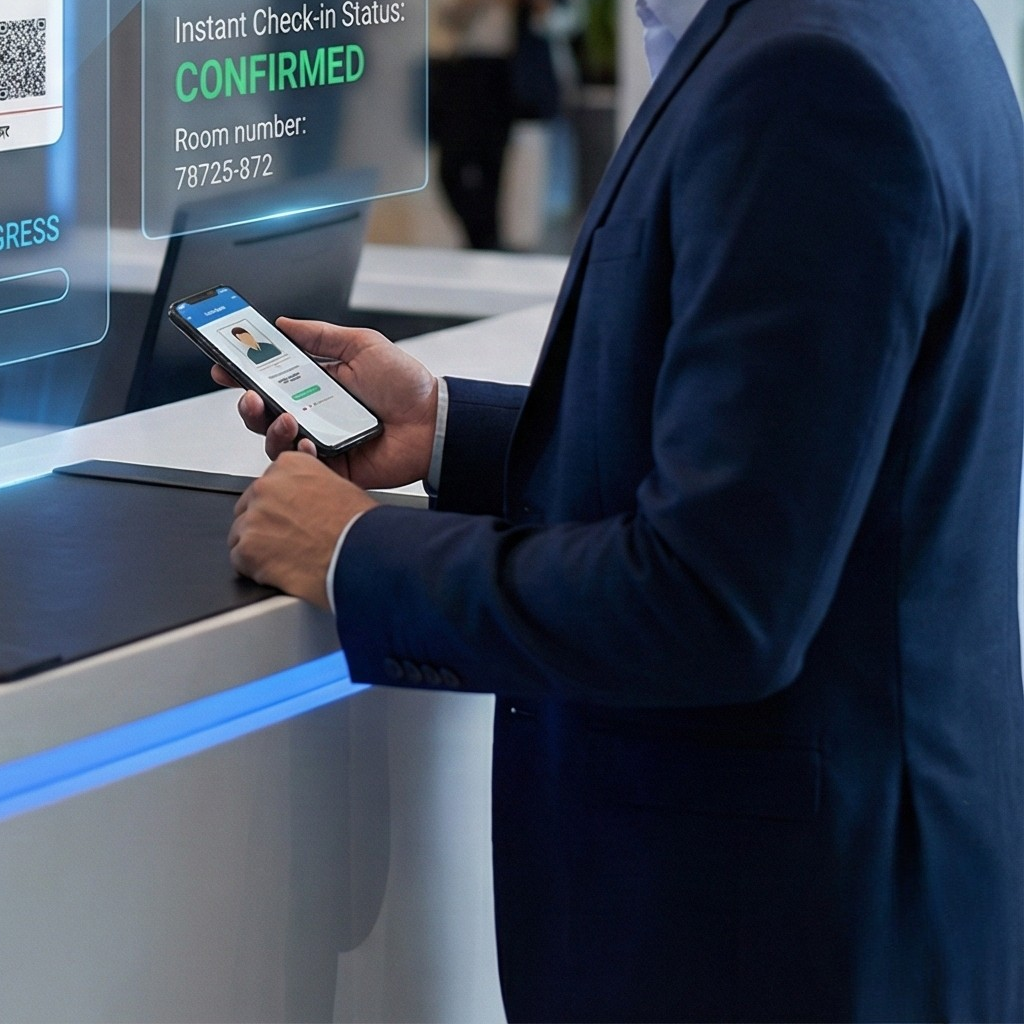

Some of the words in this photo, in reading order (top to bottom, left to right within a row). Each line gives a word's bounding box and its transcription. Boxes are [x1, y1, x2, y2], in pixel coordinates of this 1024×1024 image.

[175, 12, 247, 43] Instant
[253, 3, 336, 36] Check-in
[342, 1, 405, 27] Status:
[175, 44, 365, 103] CONFIRMED
[175, 128, 229, 152] Room
[235, 114, 307, 144] number:
[174, 154, 274, 190] 78725-872
